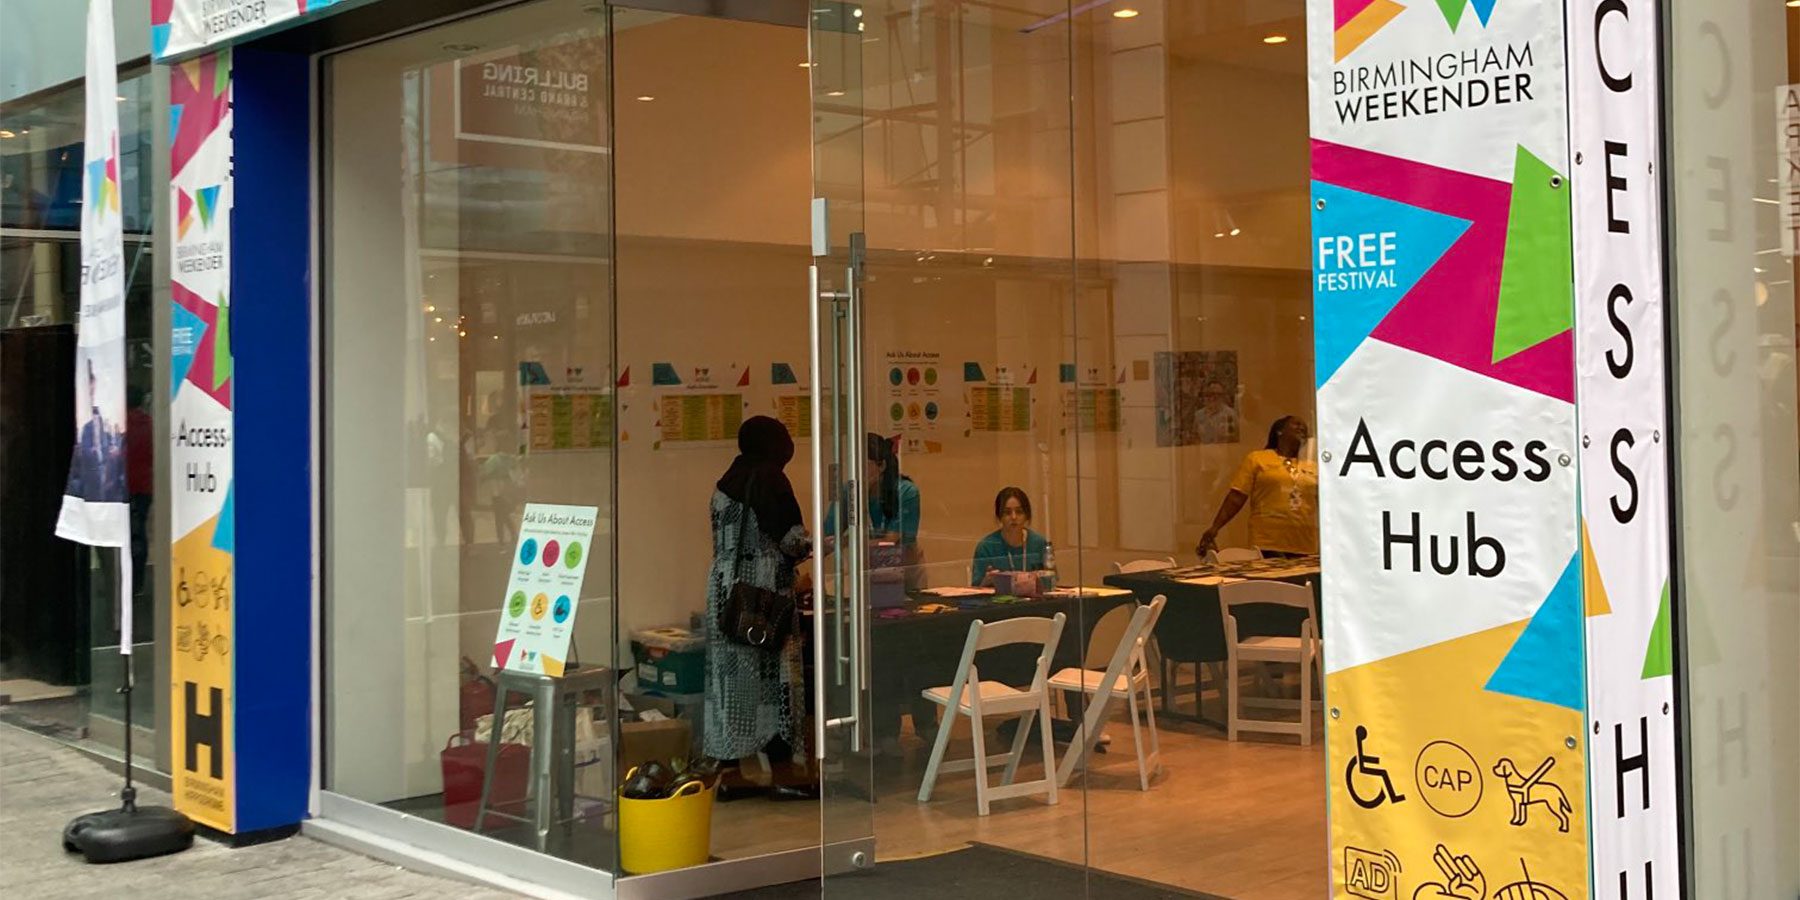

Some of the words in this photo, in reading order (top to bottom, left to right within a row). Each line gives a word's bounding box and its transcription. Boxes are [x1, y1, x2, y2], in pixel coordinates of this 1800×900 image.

[1334, 40, 1534, 95] BIRMINGHAM
[1335, 73, 1534, 125] WEEKENDER
[1319, 231, 1396, 270] FREE
[1318, 269, 1397, 292] FESTIVAL
[177, 417, 228, 448] Access
[1339, 416, 1552, 482] Access
[186, 462, 217, 493] Hub
[524, 511, 536, 523] Ask
[537, 512, 547, 524] Us
[547, 512, 569, 526] About
[570, 515, 594, 527] Access
[1382, 511, 1506, 578] Hub
[185, 681, 223, 780] H
[1424, 765, 1472, 791] CAP
[1351, 858, 1390, 893] AD
